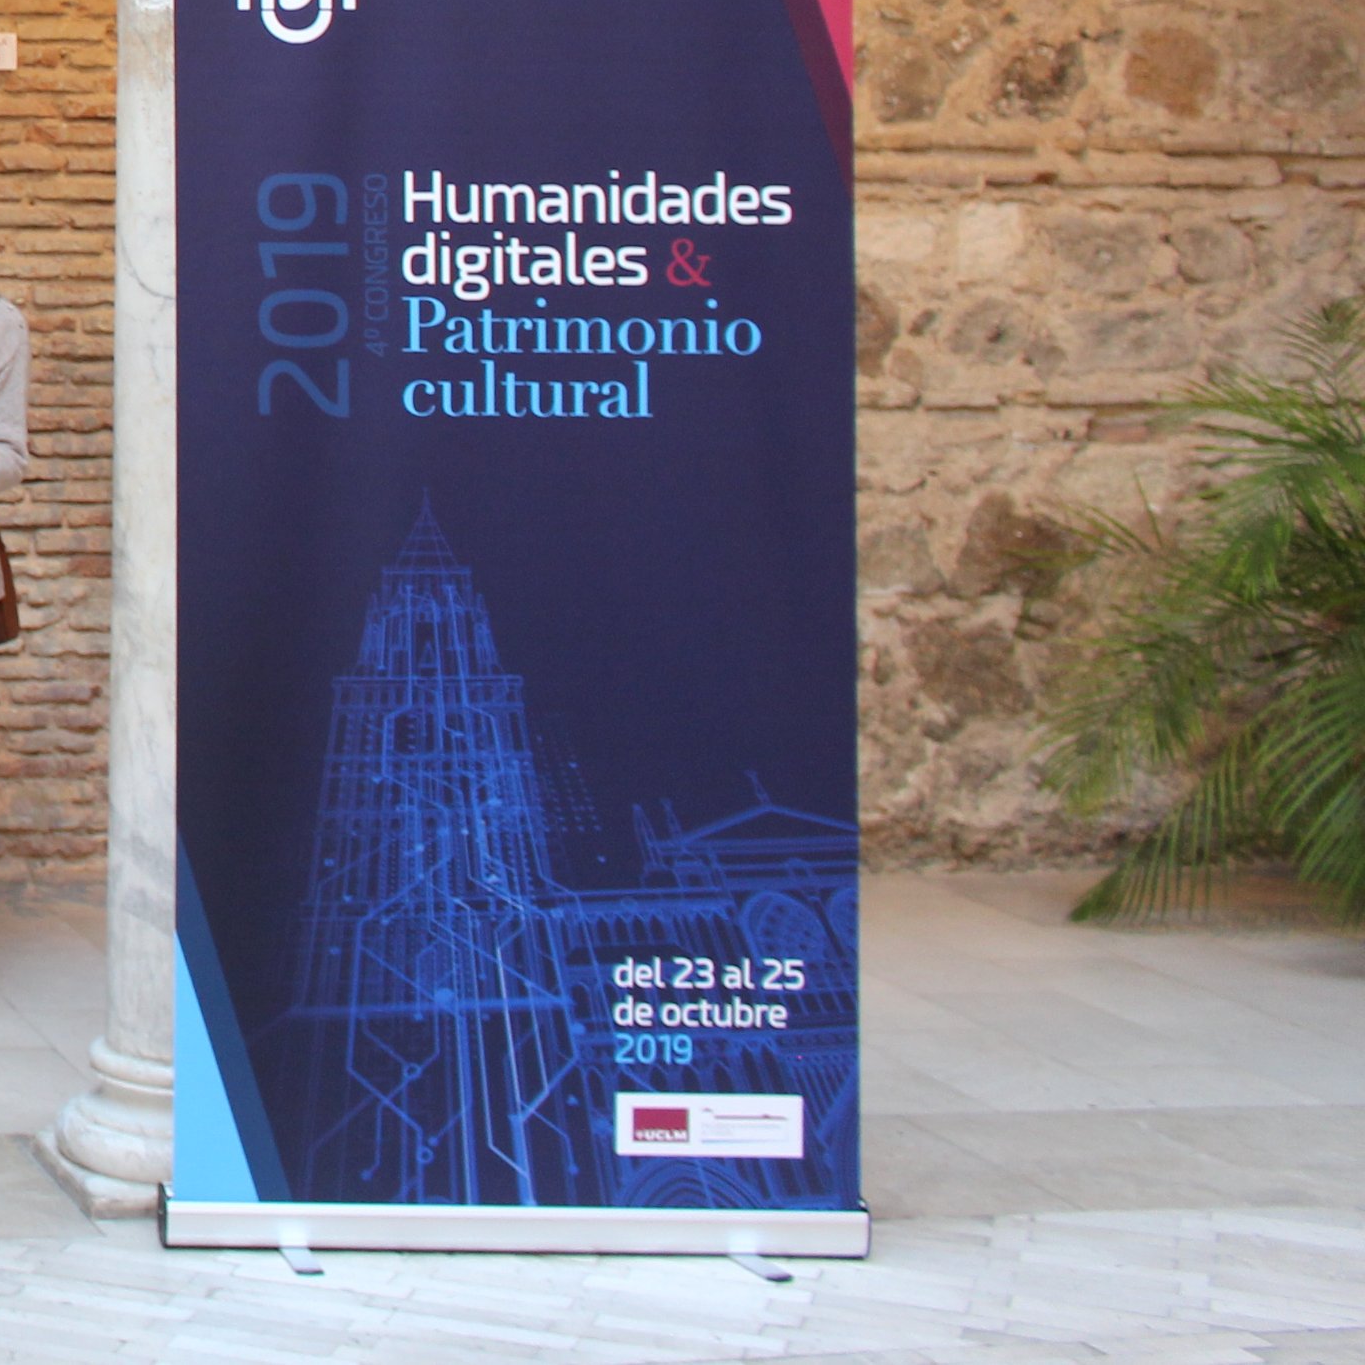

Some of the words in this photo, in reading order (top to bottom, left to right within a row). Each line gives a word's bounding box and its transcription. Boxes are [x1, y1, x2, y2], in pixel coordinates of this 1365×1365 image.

[403, 169, 793, 226] Humanidades
[364, 173, 390, 322] CONGRESO
[401, 231, 649, 302] digitales
[666, 238, 713, 288] &
[258, 173, 350, 419] 2019
[401, 296, 762, 357] Patrimonio
[402, 359, 654, 419] cultural
[613, 955, 665, 989] del
[671, 957, 715, 990] 23
[722, 956, 755, 990] al
[761, 958, 806, 991] 25
[613, 995, 654, 1027] de
[660, 997, 788, 1029] octubre
[614, 1033, 693, 1065] 2019
[644, 1129, 688, 1141] UCLM
